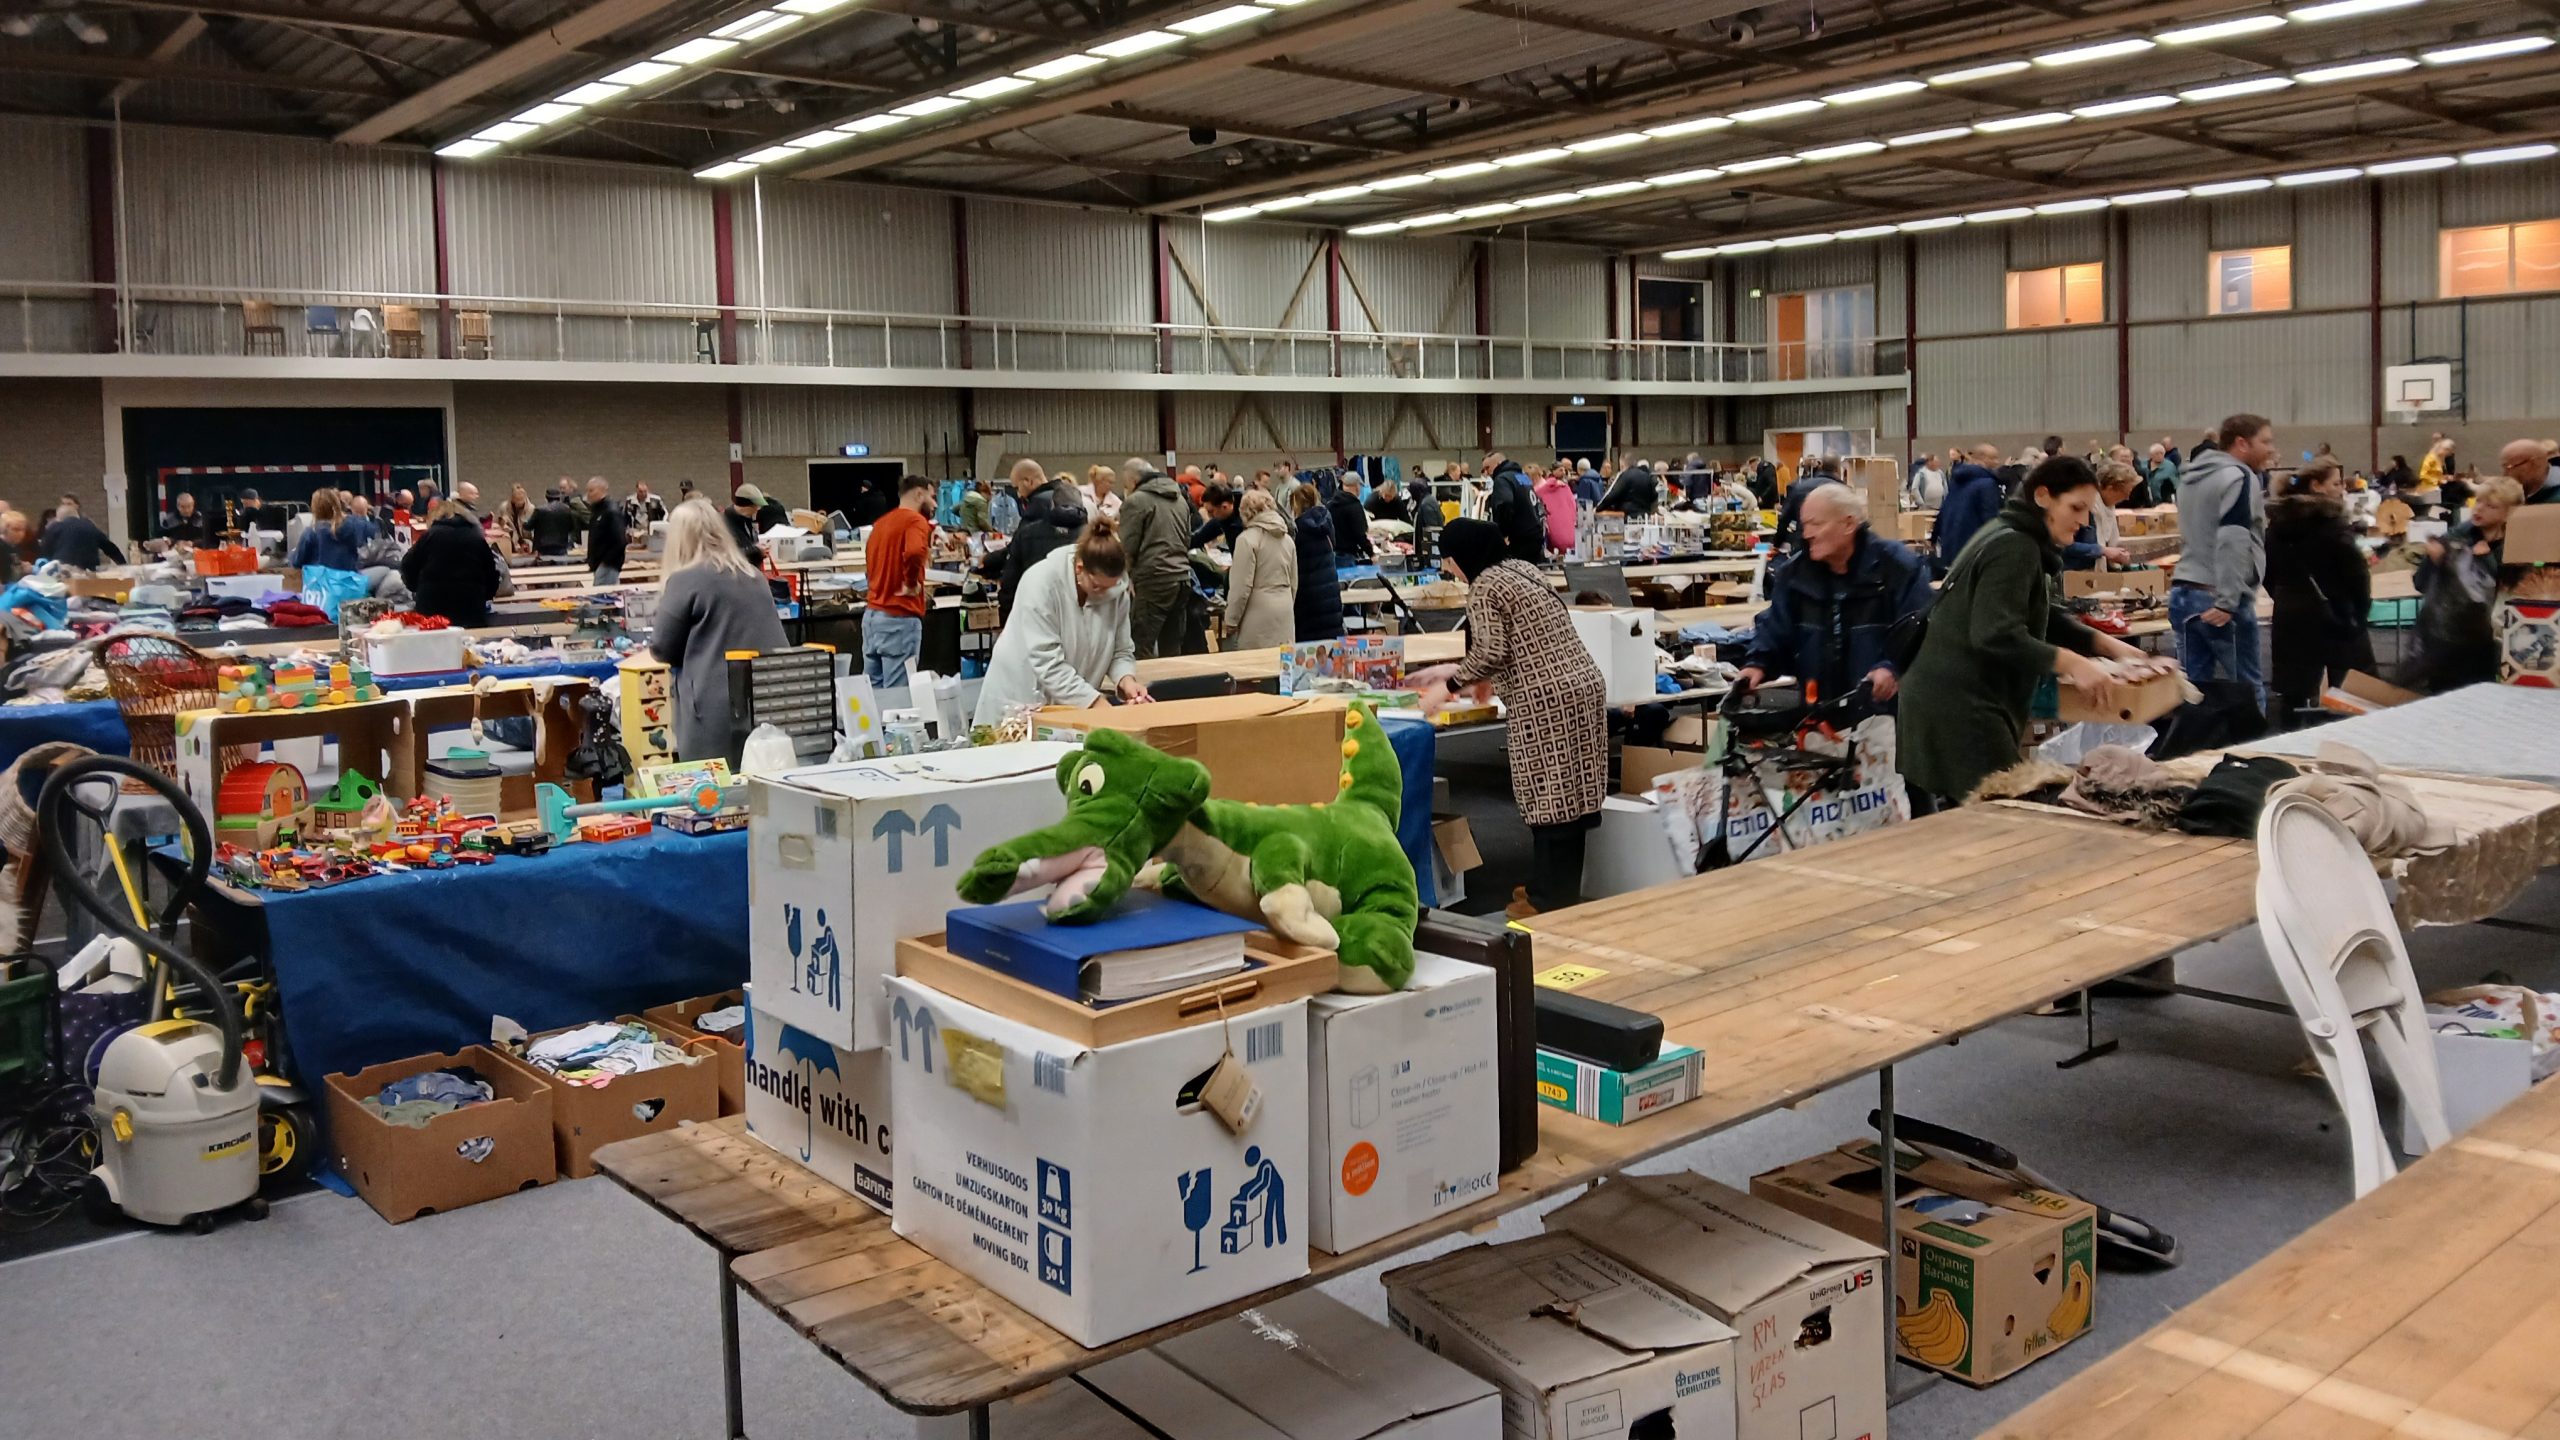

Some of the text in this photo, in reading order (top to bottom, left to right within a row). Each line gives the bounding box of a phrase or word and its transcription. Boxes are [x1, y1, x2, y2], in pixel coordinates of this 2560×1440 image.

[1811, 788, 1888, 825] ACION
[1729, 811, 1768, 837] CTIO
[745, 1057, 892, 1155] handle with c
[966, 1151, 1029, 1191] VERHUISDOOS
[955, 1172, 1029, 1219] UMZUGSKARTON
[912, 1176, 1029, 1246] CARTON DE DÉMÉNAGEMENT
[1041, 1199, 1068, 1223] 30 kg
[972, 1232, 1029, 1273] MOVING BOX
[1925, 1248, 1969, 1275] Organic
[1045, 1265, 1066, 1286] 50 L
[1923, 1264, 1970, 1289] Bananas
[1809, 1282, 1843, 1301] UniGroup
[1753, 1314, 1777, 1352] RM
[1676, 1376, 1722, 1399] VERHUIZERS
[1687, 1366, 1721, 1385] ERKENDE
